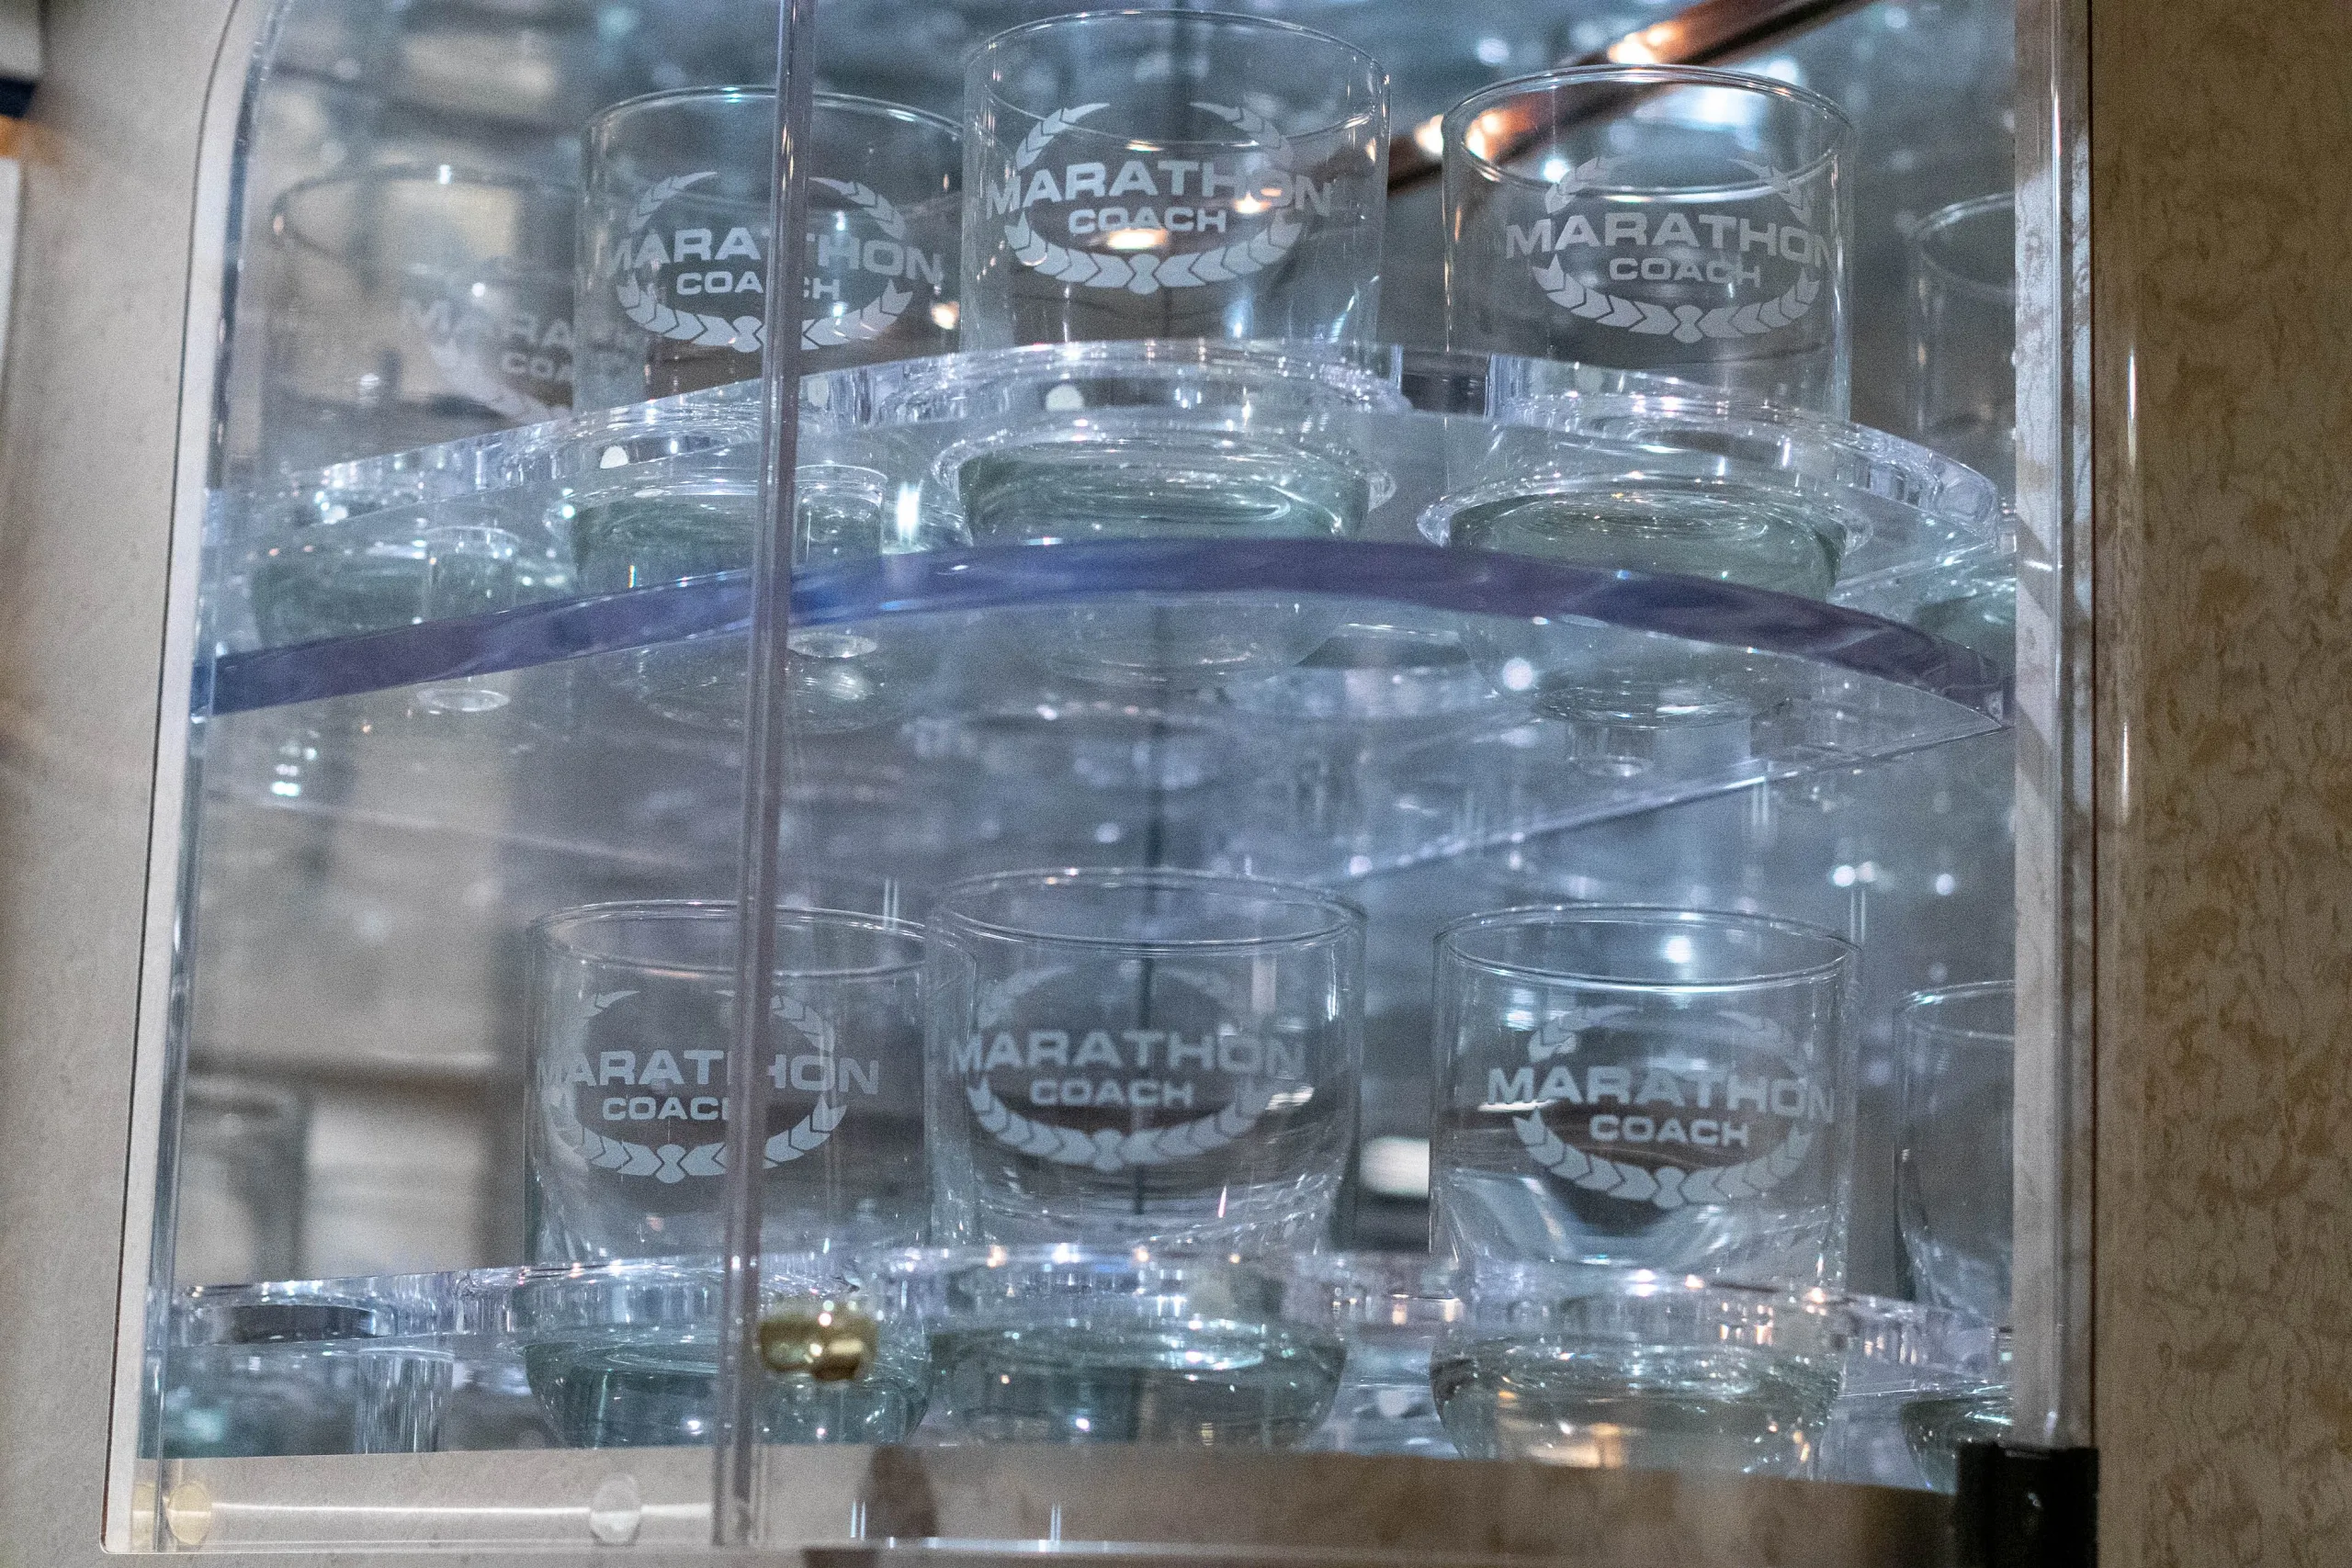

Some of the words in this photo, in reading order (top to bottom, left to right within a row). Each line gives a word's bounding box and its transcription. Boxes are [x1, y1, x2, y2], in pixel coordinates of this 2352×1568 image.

[987, 159, 1332, 219] MARATHON
[1068, 206, 1227, 234] COACH
[606, 226, 944, 285] MARAHON
[1505, 211, 1836, 273] MARATHON
[676, 271, 841, 299] COAH
[1609, 257, 1761, 288] COACH
[949, 1029, 1308, 1077] MARATHON
[1030, 1079, 1193, 1107] COACH
[1486, 1065, 1836, 1123] MARATHON
[1589, 1113, 1748, 1147] COACH
